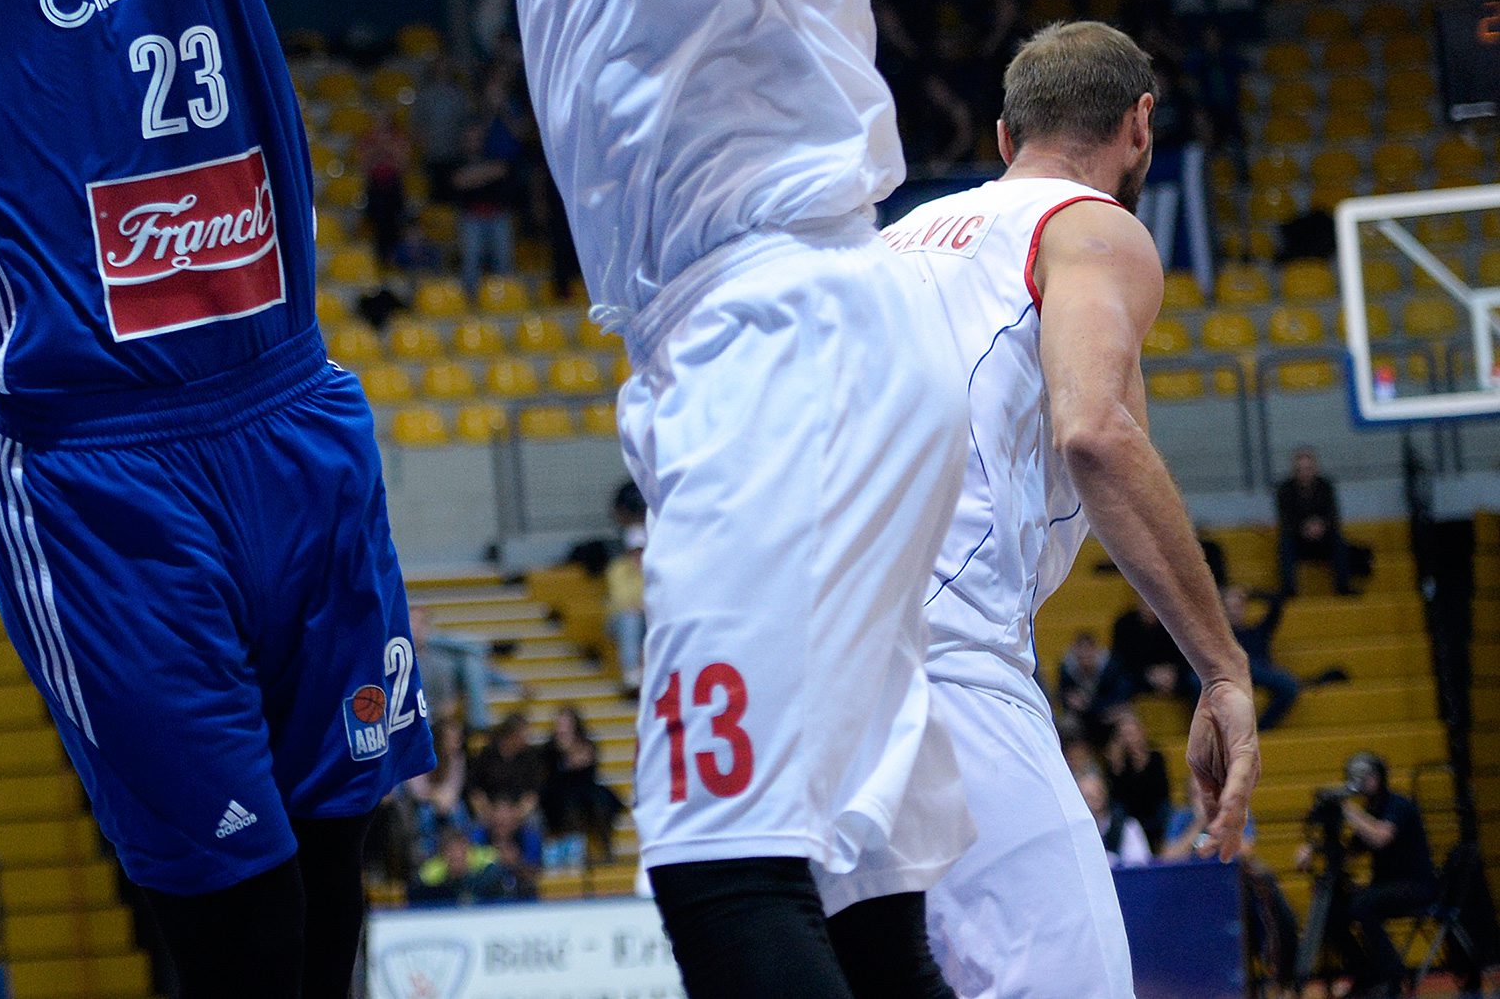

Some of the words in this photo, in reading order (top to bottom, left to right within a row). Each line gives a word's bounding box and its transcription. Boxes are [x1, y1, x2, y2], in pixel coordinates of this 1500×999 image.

[128, 25, 229, 139] 23
[107, 178, 274, 267] Franck
[384, 636, 427, 735] 2
[355, 723, 387, 754] ABA
[654, 662, 755, 804] 13
[215, 812, 258, 839] adidas
